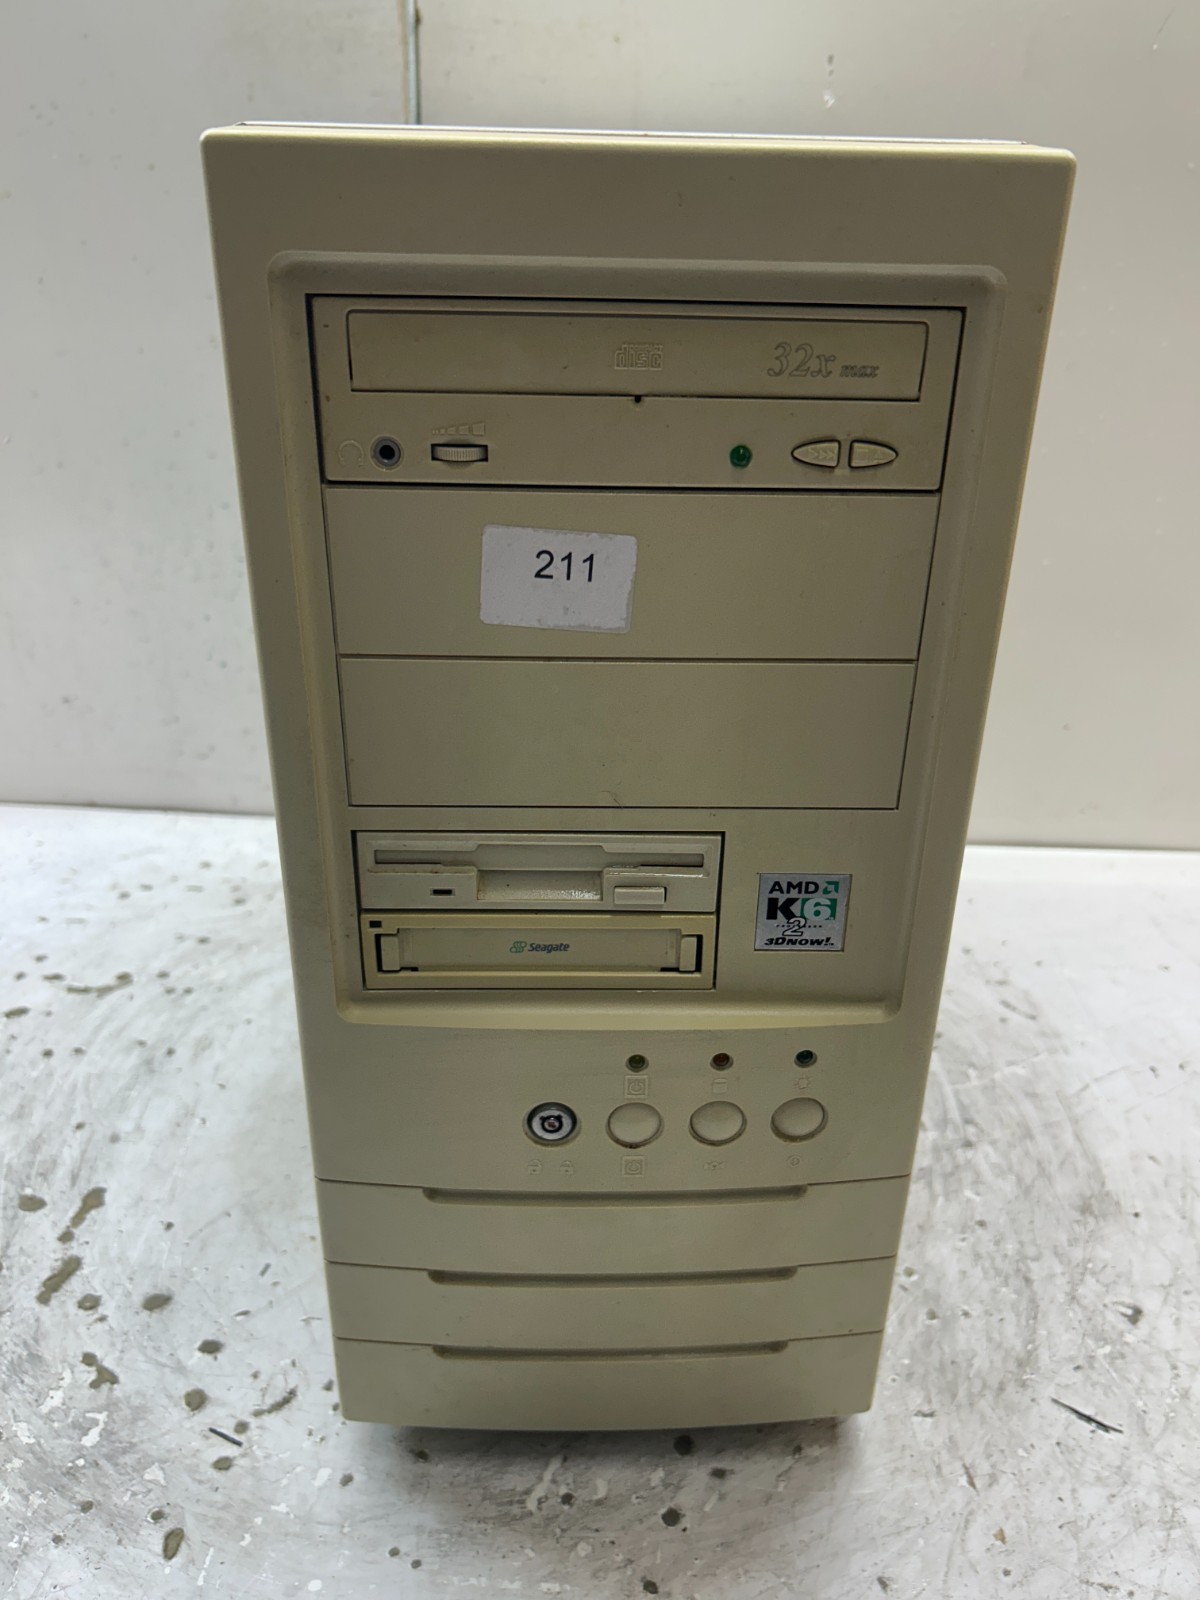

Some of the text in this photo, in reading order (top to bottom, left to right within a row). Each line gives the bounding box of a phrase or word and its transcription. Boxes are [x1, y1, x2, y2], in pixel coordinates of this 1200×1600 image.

[534, 549, 594, 582] 211
[768, 881, 819, 895] AMD
[766, 897, 836, 921] K6
[528, 942, 570, 953] Seagate
